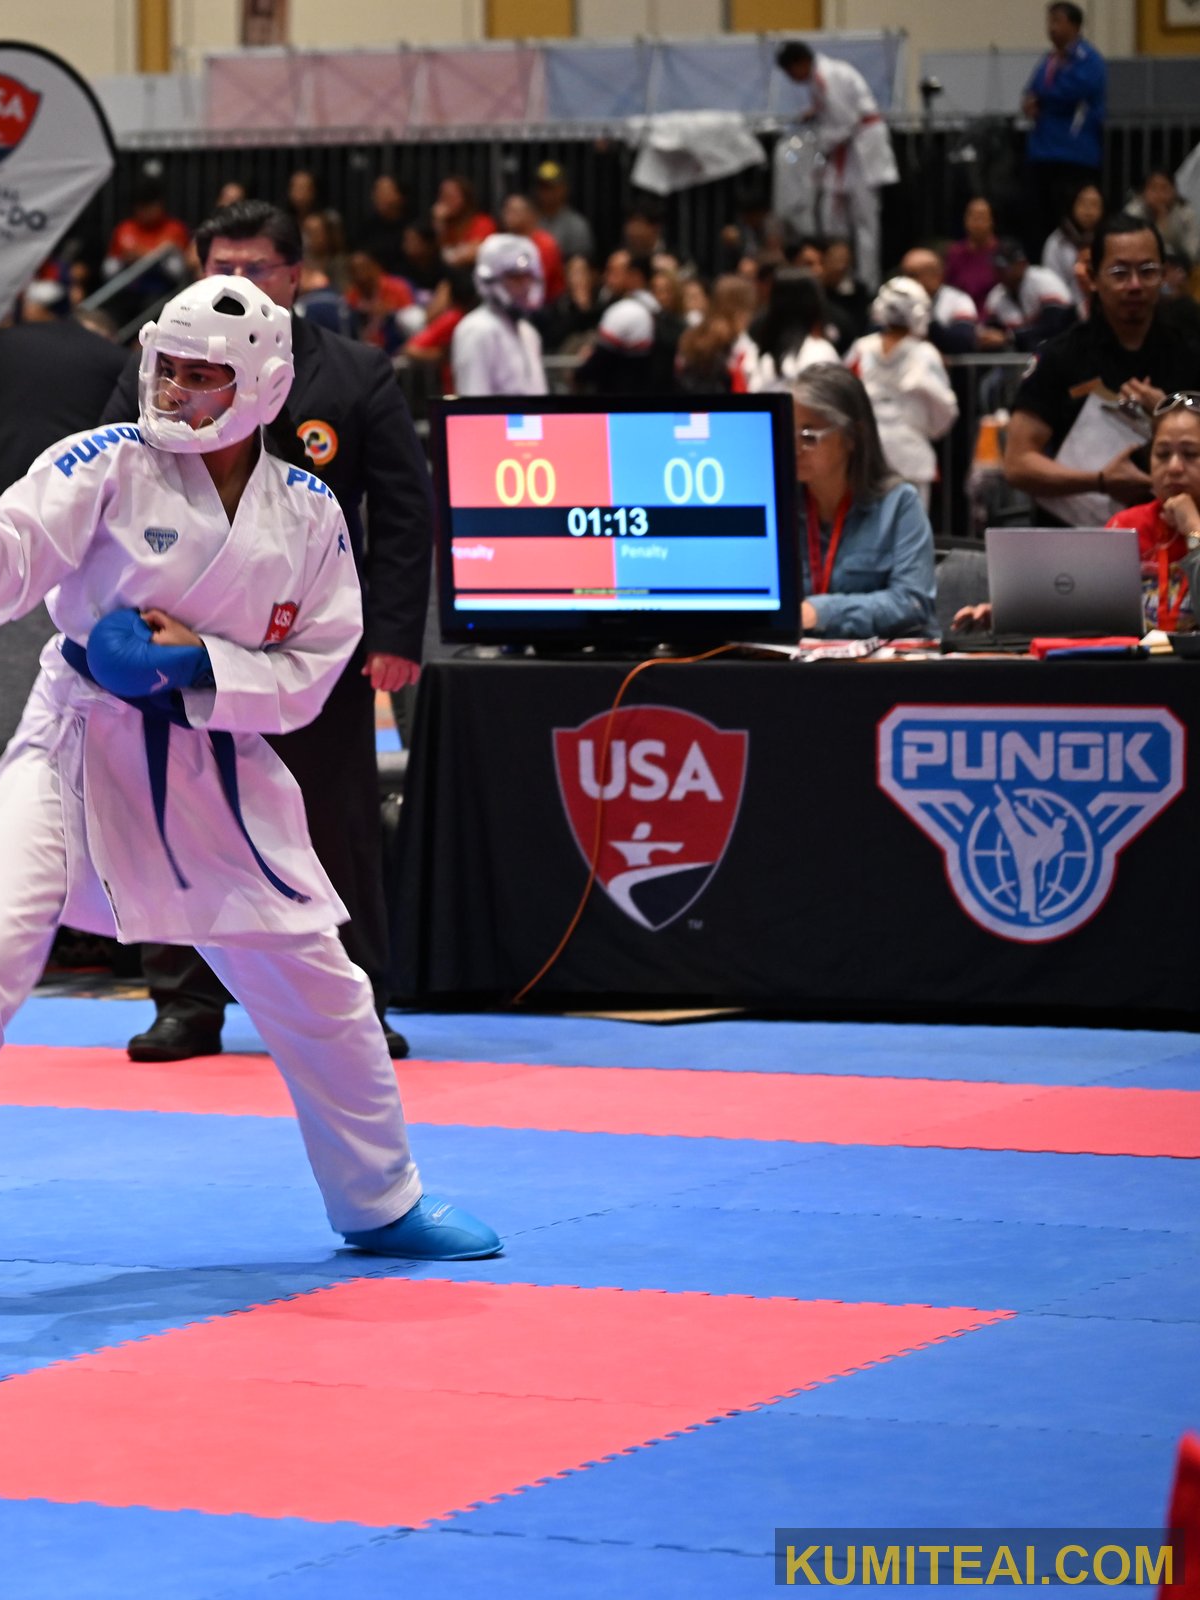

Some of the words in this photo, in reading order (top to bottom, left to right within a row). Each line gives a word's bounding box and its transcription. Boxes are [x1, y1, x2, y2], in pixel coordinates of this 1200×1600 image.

[286, 467, 334, 498] PU
[495, 458, 556, 506] 00
[663, 457, 725, 505] 00
[567, 507, 649, 537] 01:13
[620, 544, 669, 560] Penalty
[578, 739, 724, 802] USA
